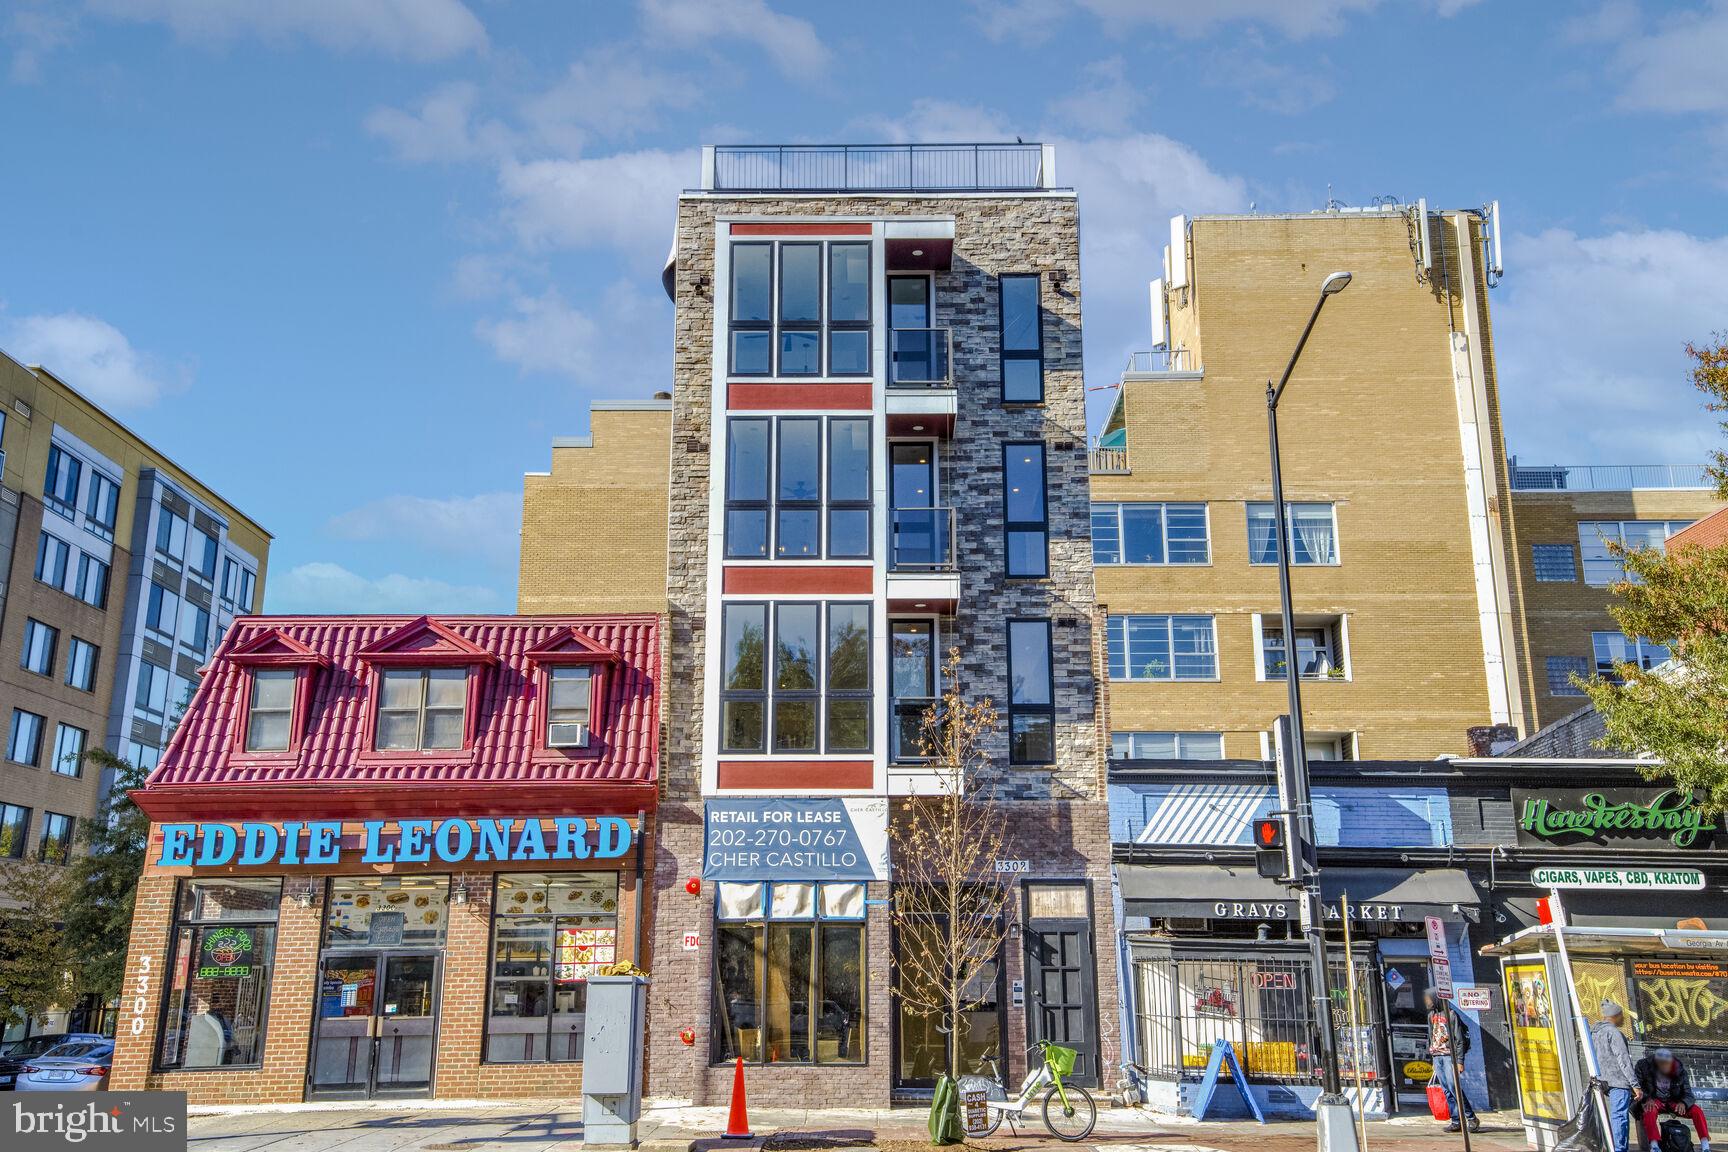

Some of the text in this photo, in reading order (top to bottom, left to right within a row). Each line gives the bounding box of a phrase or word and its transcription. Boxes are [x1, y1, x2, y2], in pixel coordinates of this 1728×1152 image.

[710, 811, 842, 823] RETAIL FOR LEASE
[1519, 788, 1717, 847] Hawkesbay
[157, 816, 633, 867] EDDIE LEONARD
[710, 829, 847, 846] 202-270-0767
[709, 852, 857, 867] CHER CASTILLO
[997, 861, 1027, 871] 3302
[1538, 870, 1700, 886] CIGARS, VAPES, CBD, KRATOM
[1214, 902, 1288, 918] GRAYS
[1322, 904, 1402, 920] ARKET
[204, 927, 252, 951] CHINESE FOOD
[1686, 940, 1712, 948] Georgia
[1251, 973, 1294, 988] OPEN
[132, 955, 152, 1035] 3300
[967, 1093, 986, 1102] CASH
